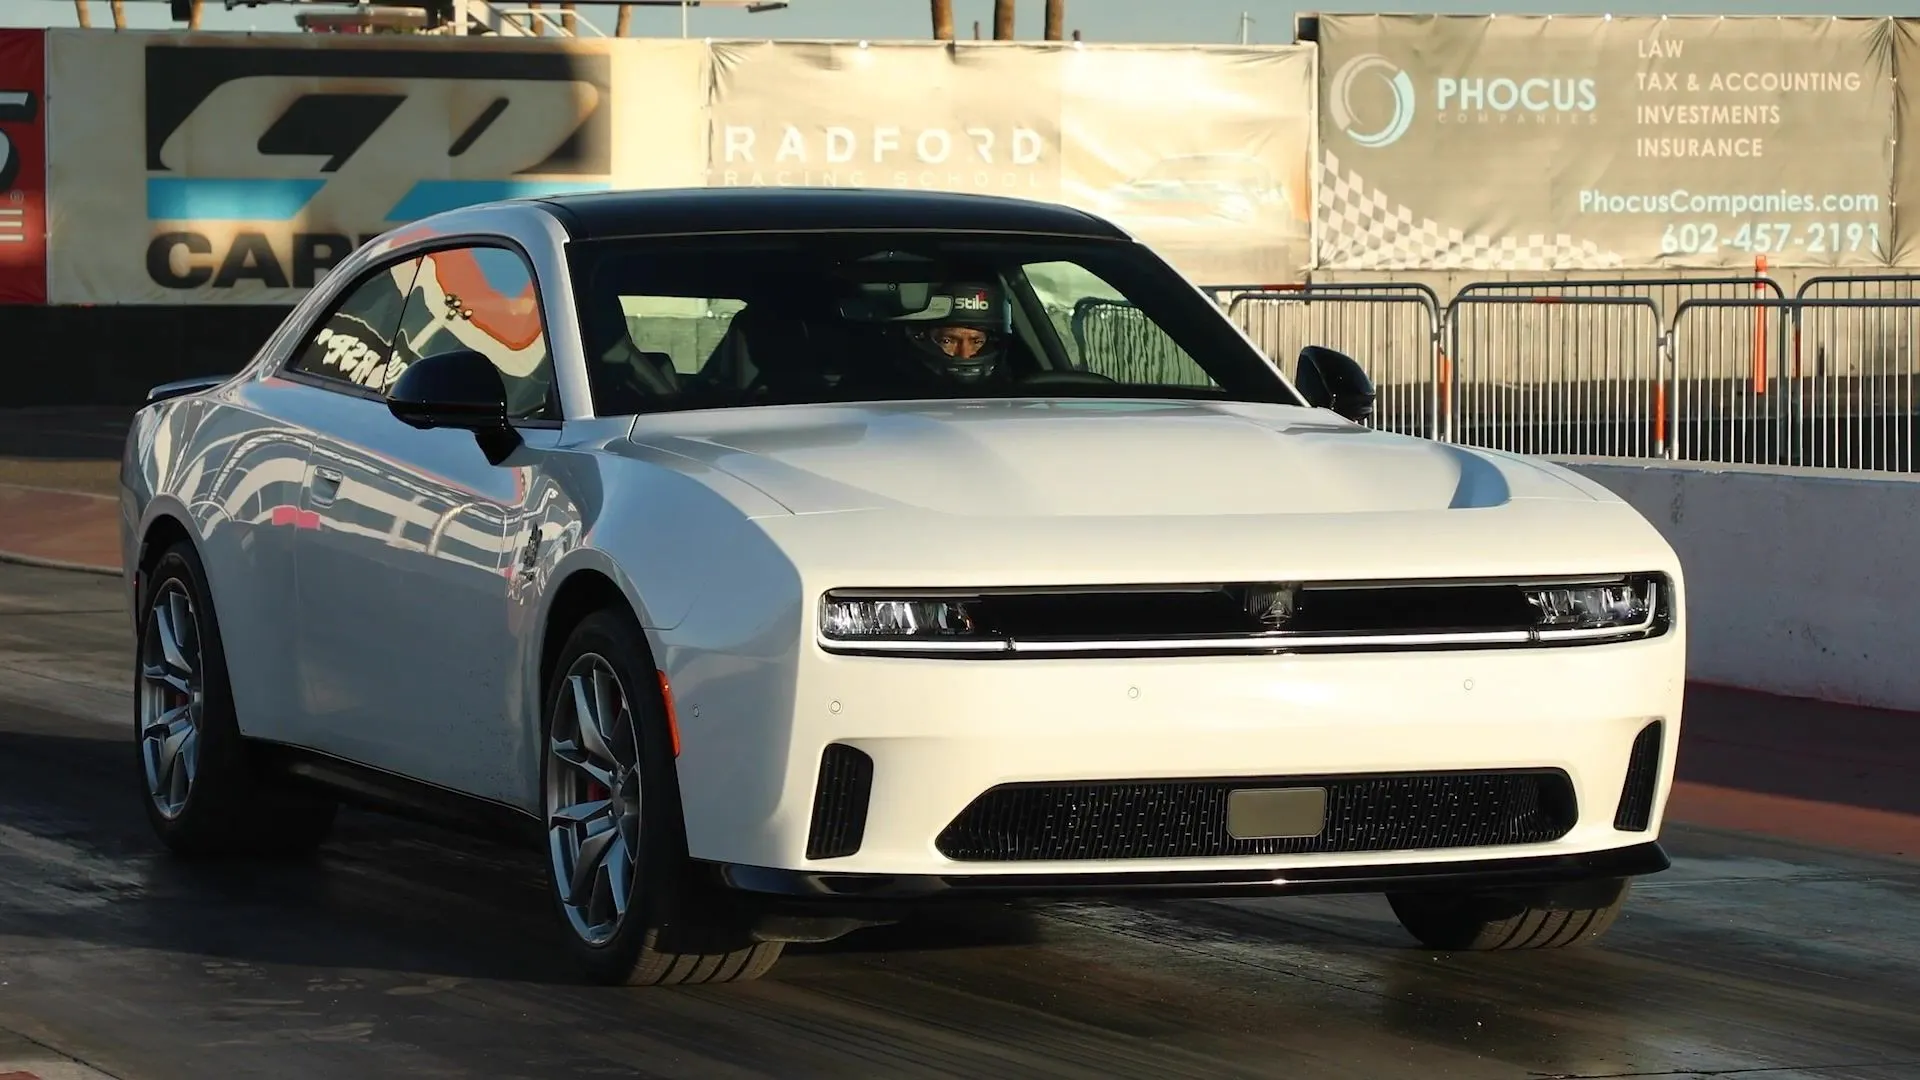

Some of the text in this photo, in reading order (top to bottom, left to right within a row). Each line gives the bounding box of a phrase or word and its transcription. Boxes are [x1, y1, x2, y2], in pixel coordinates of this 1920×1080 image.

[1637, 39, 1684, 59] LAW
[1636, 71, 1862, 92] TAX & ACCOUNTING
[1437, 77, 1597, 112] PHOCUS
[1437, 112, 1598, 125] COMPANIES
[1636, 105, 1781, 125] INVESTMENTS
[724, 125, 1043, 164] RADFORD
[1636, 138, 1763, 158] INSURANCE
[723, 170, 1045, 188] RACING SCHOOL
[1578, 188, 1880, 217] PhocusCompanies.com
[1661, 222, 1880, 253] 602-457-2191
[954, 294, 989, 310] Stilo
